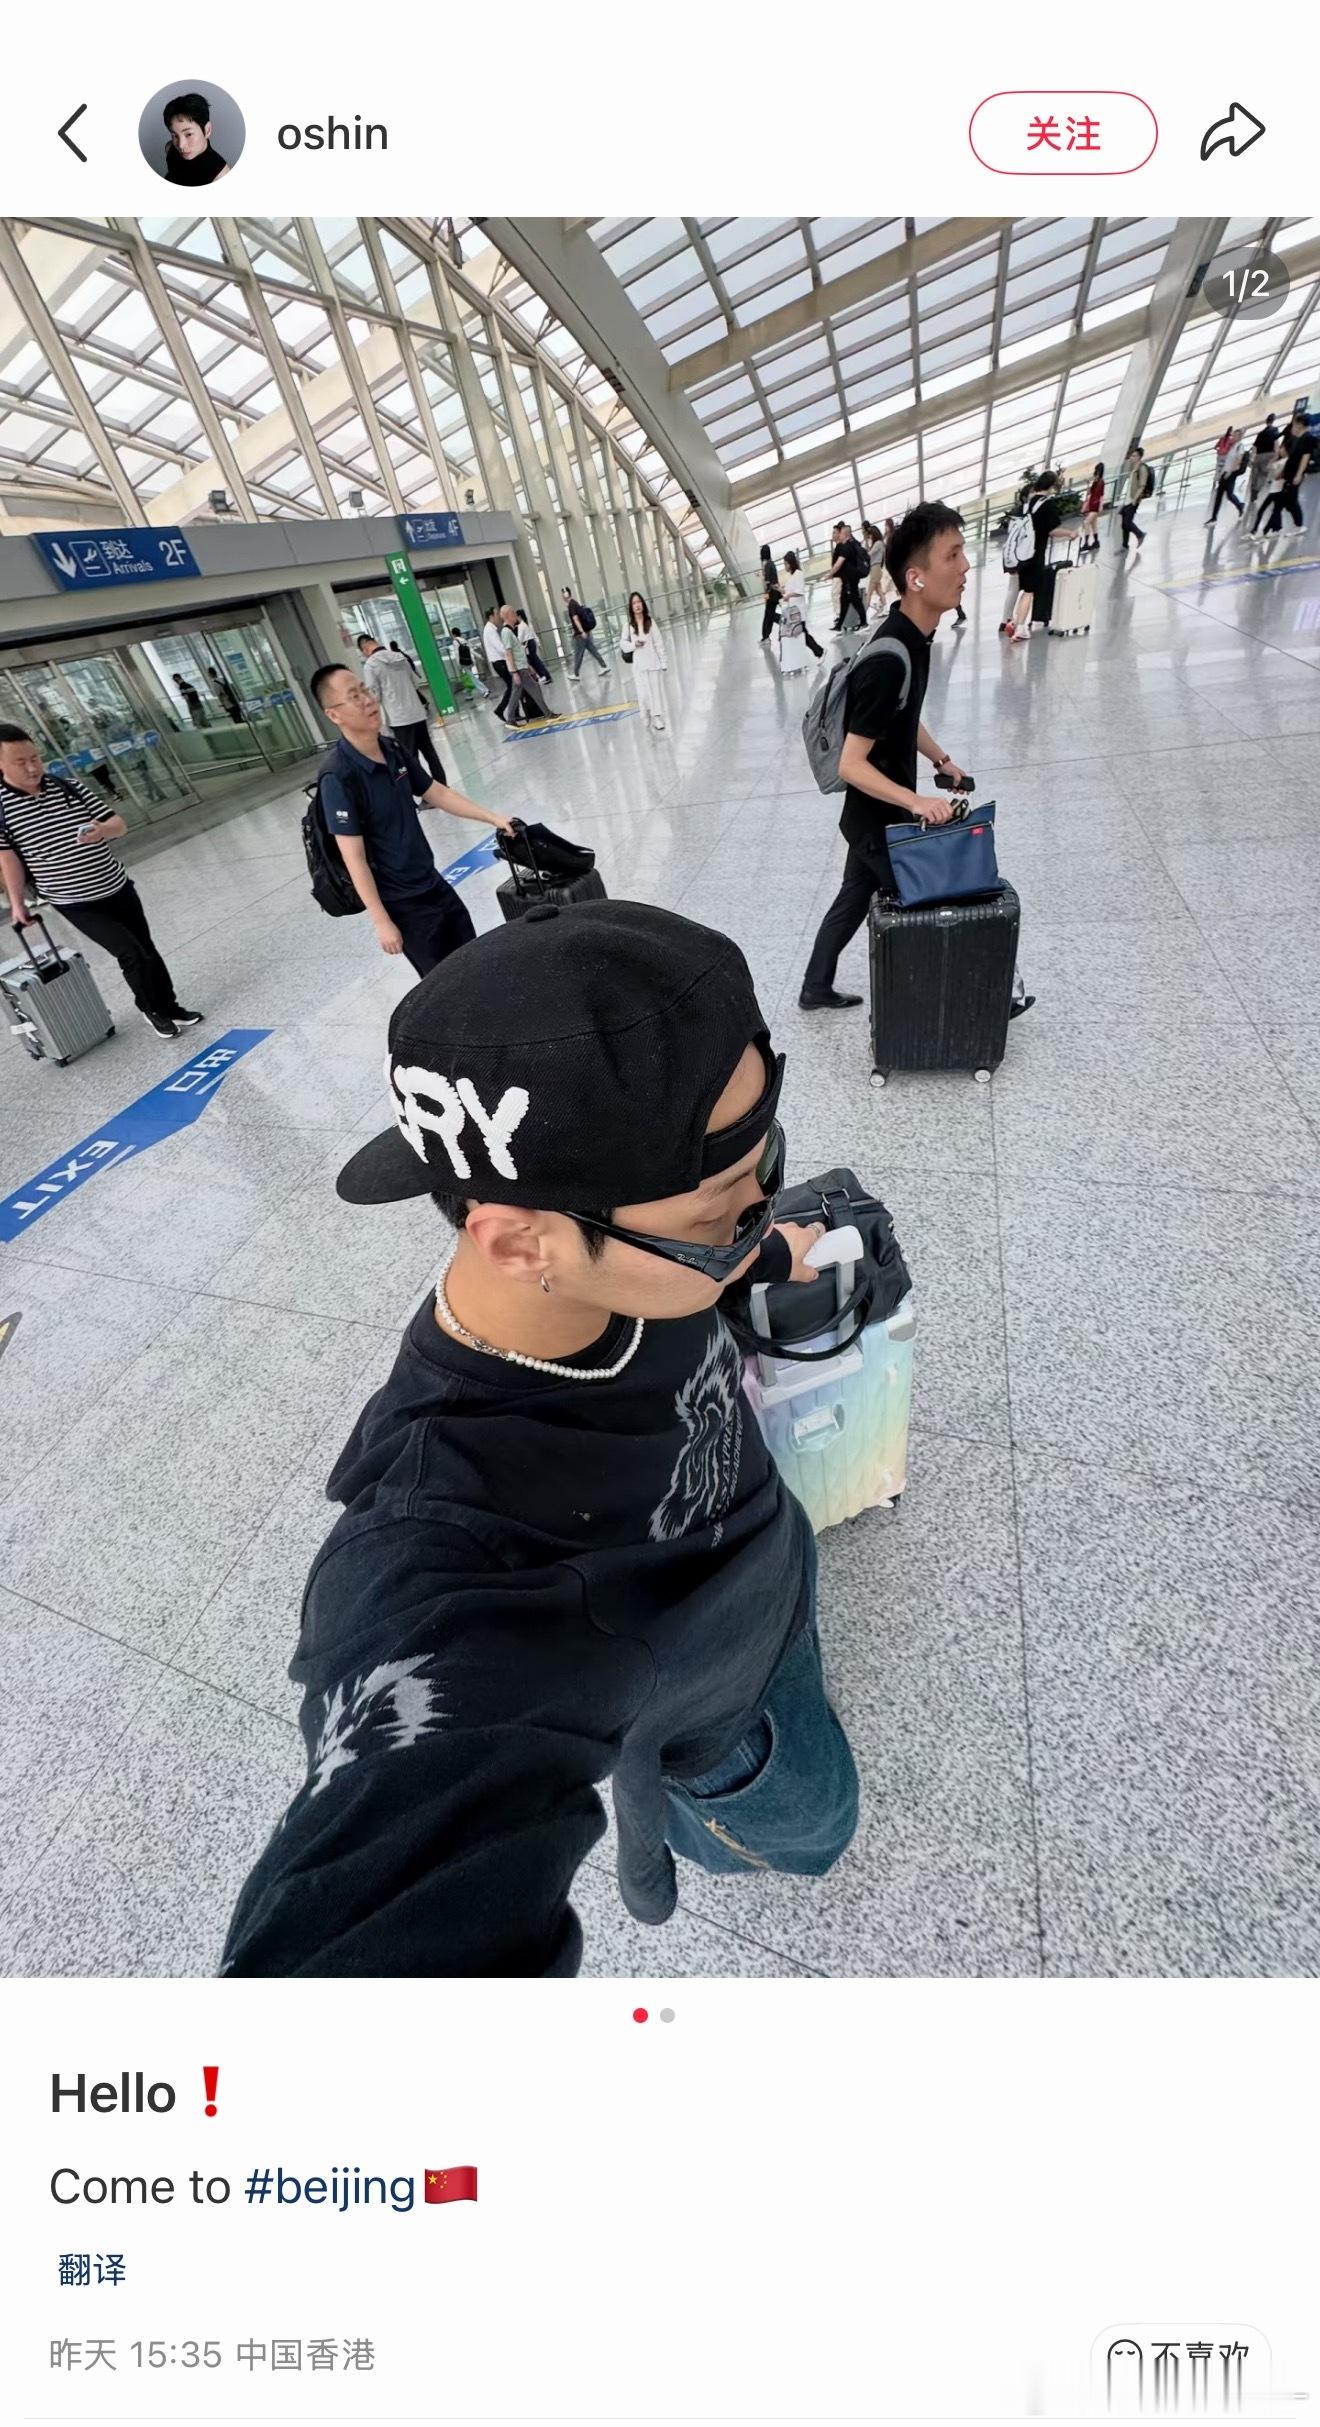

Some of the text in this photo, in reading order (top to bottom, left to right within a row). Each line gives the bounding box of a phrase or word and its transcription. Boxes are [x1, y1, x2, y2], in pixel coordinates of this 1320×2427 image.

[100, 538, 134, 561] 到达
[159, 539, 187, 567] 2F
[112, 560, 154, 575] Arrivals
[163, 1047, 239, 1093] 出口
[11, 1139, 120, 1221] EXIT
